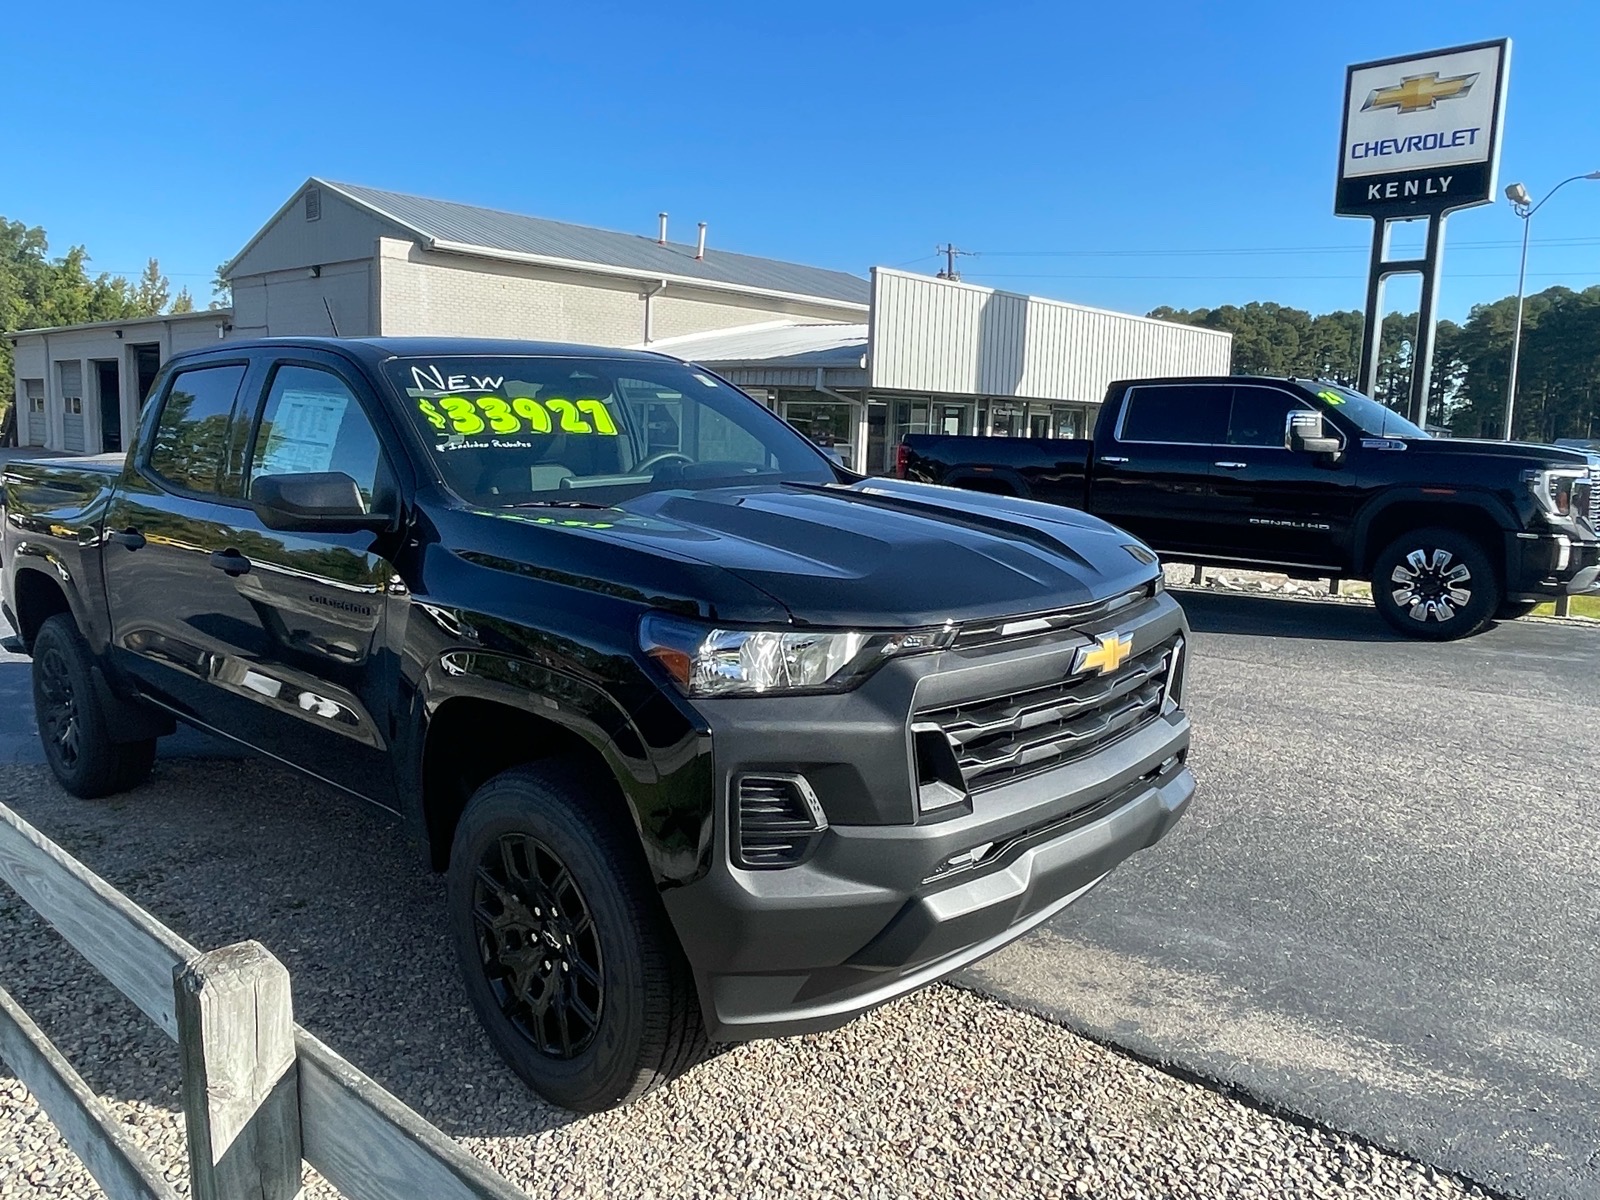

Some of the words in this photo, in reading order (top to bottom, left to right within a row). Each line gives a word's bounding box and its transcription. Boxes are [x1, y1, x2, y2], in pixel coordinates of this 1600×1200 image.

[1351, 128, 1480, 159] CHEVROLET
[1367, 176, 1453, 200] KENLY
[410, 365, 504, 391] NEW
[418, 397, 618, 435] $33927
[1249, 518, 1305, 528] DENALI
